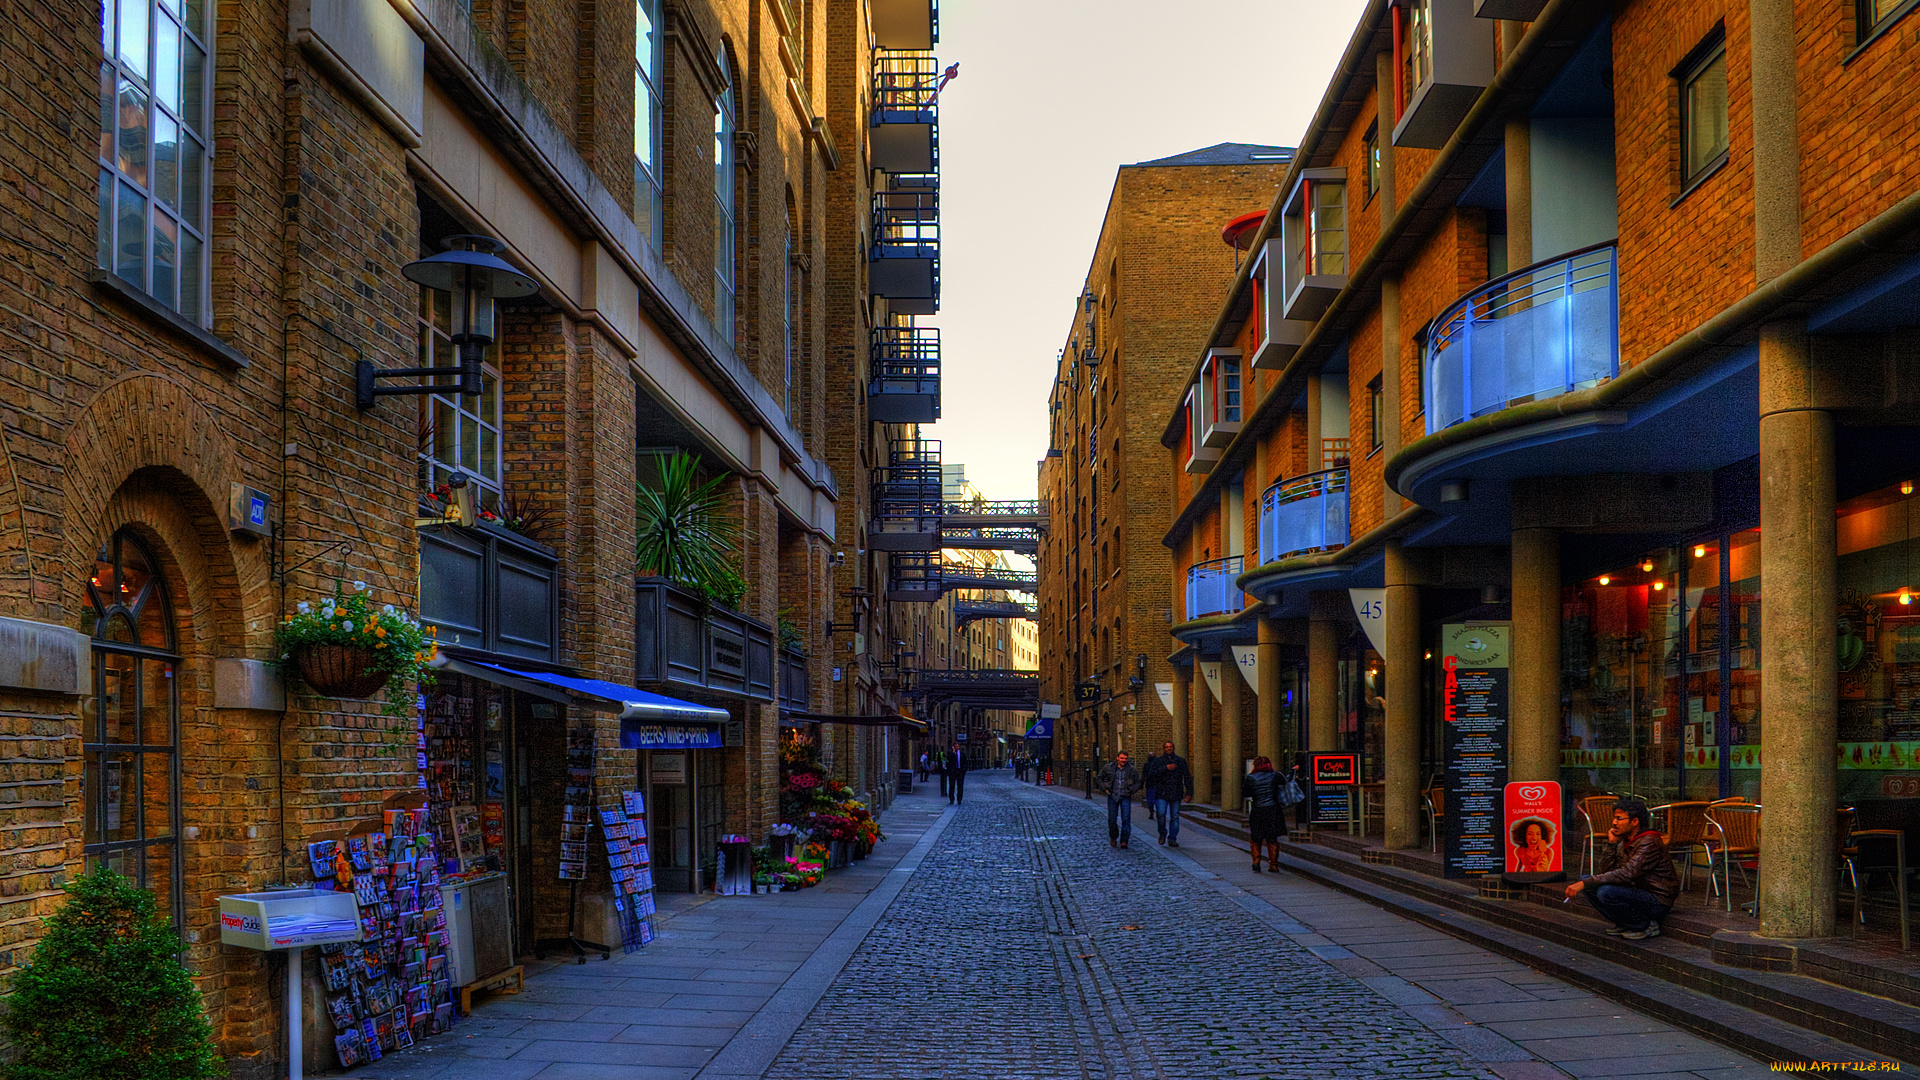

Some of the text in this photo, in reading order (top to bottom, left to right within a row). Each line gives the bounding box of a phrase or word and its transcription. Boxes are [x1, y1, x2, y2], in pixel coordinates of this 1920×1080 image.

[1360, 601, 1382, 619] 45
[1239, 653, 1256, 666] 43
[1488, 652, 1500, 663] BAR
[1207, 668, 1218, 680] 41
[1081, 687, 1095, 698] 37
[1444, 655, 1458, 722] CAFE
[640, 725, 665, 745] BEERS
[666, 726, 686, 744] WINES
[689, 727, 710, 744] SPIRITS
